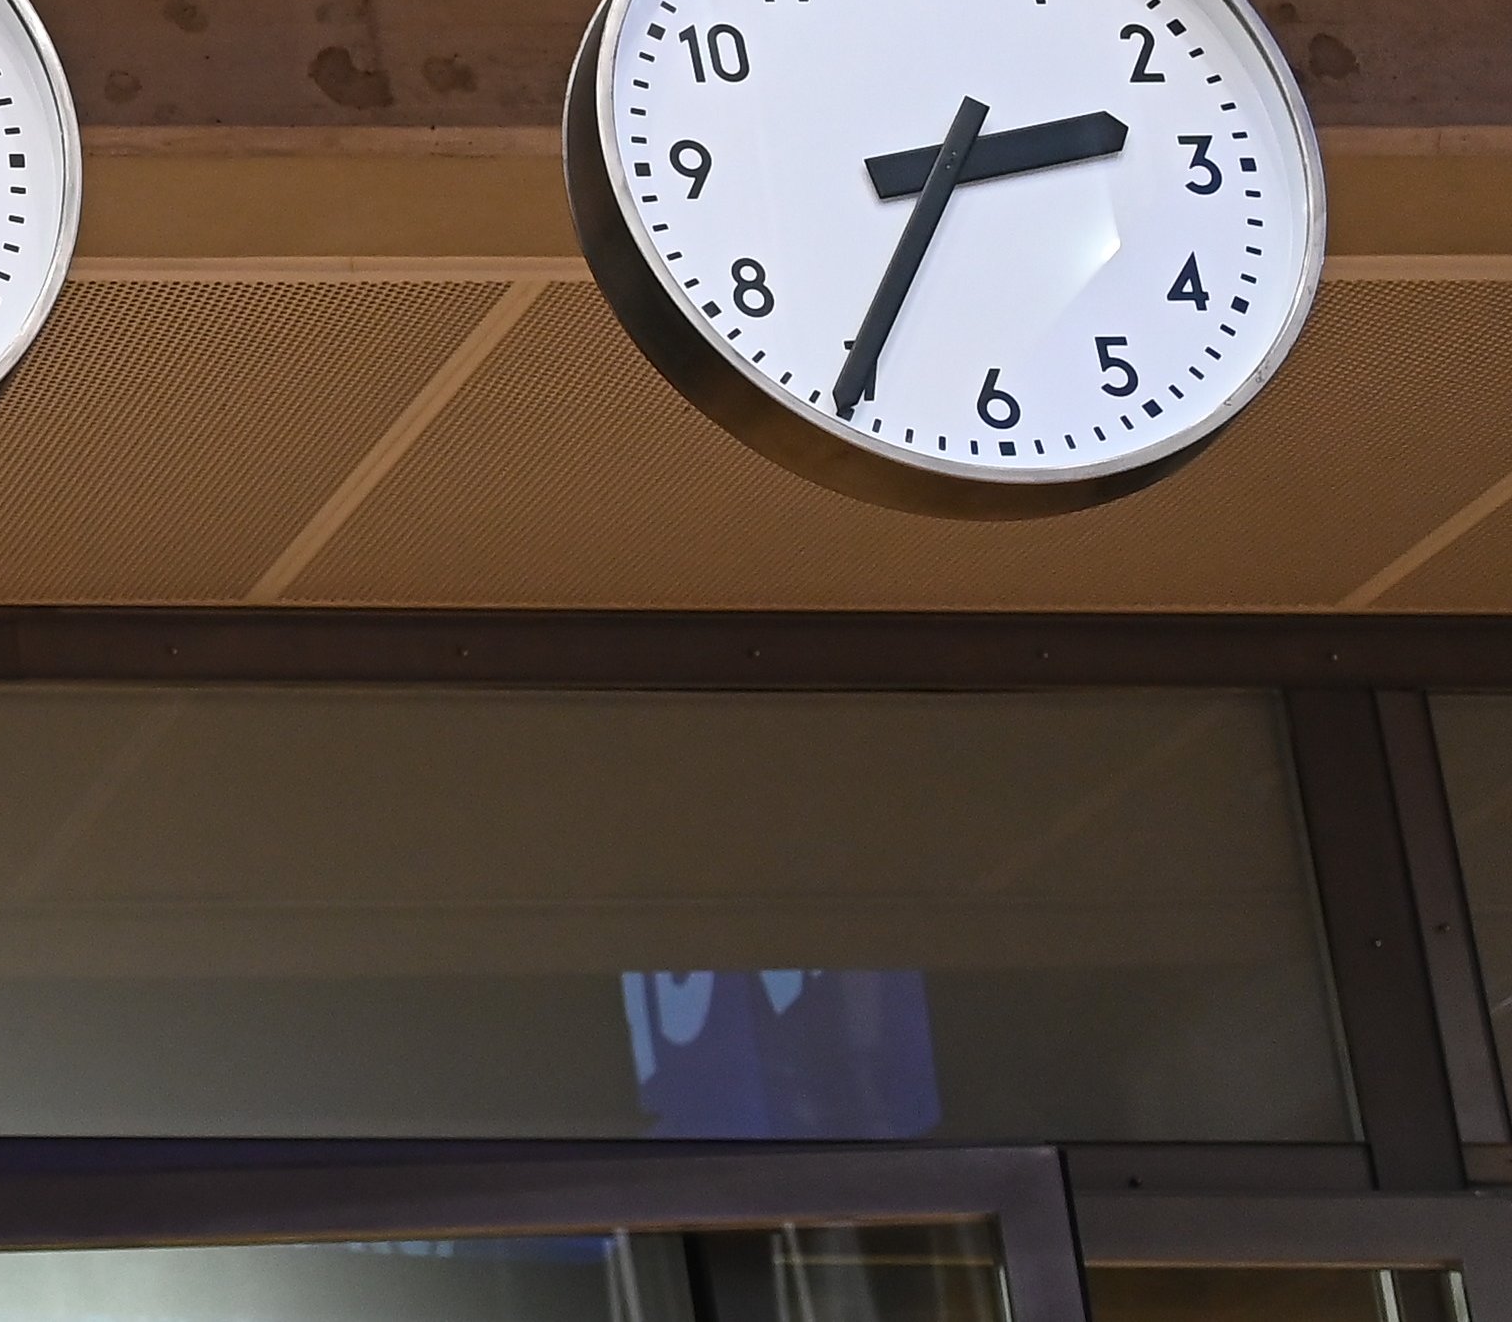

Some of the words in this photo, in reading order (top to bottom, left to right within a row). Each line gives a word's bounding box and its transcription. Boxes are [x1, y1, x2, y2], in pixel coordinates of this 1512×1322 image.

[678, 23, 750, 83] 10
[1119, 23, 1166, 83] 2
[669, 139, 712, 200] 9
[1177, 134, 1223, 196] 3
[731, 257, 775, 318] 8
[1166, 251, 1210, 312] 4
[1094, 336, 1139, 398] 5
[976, 368, 1021, 430] 6
